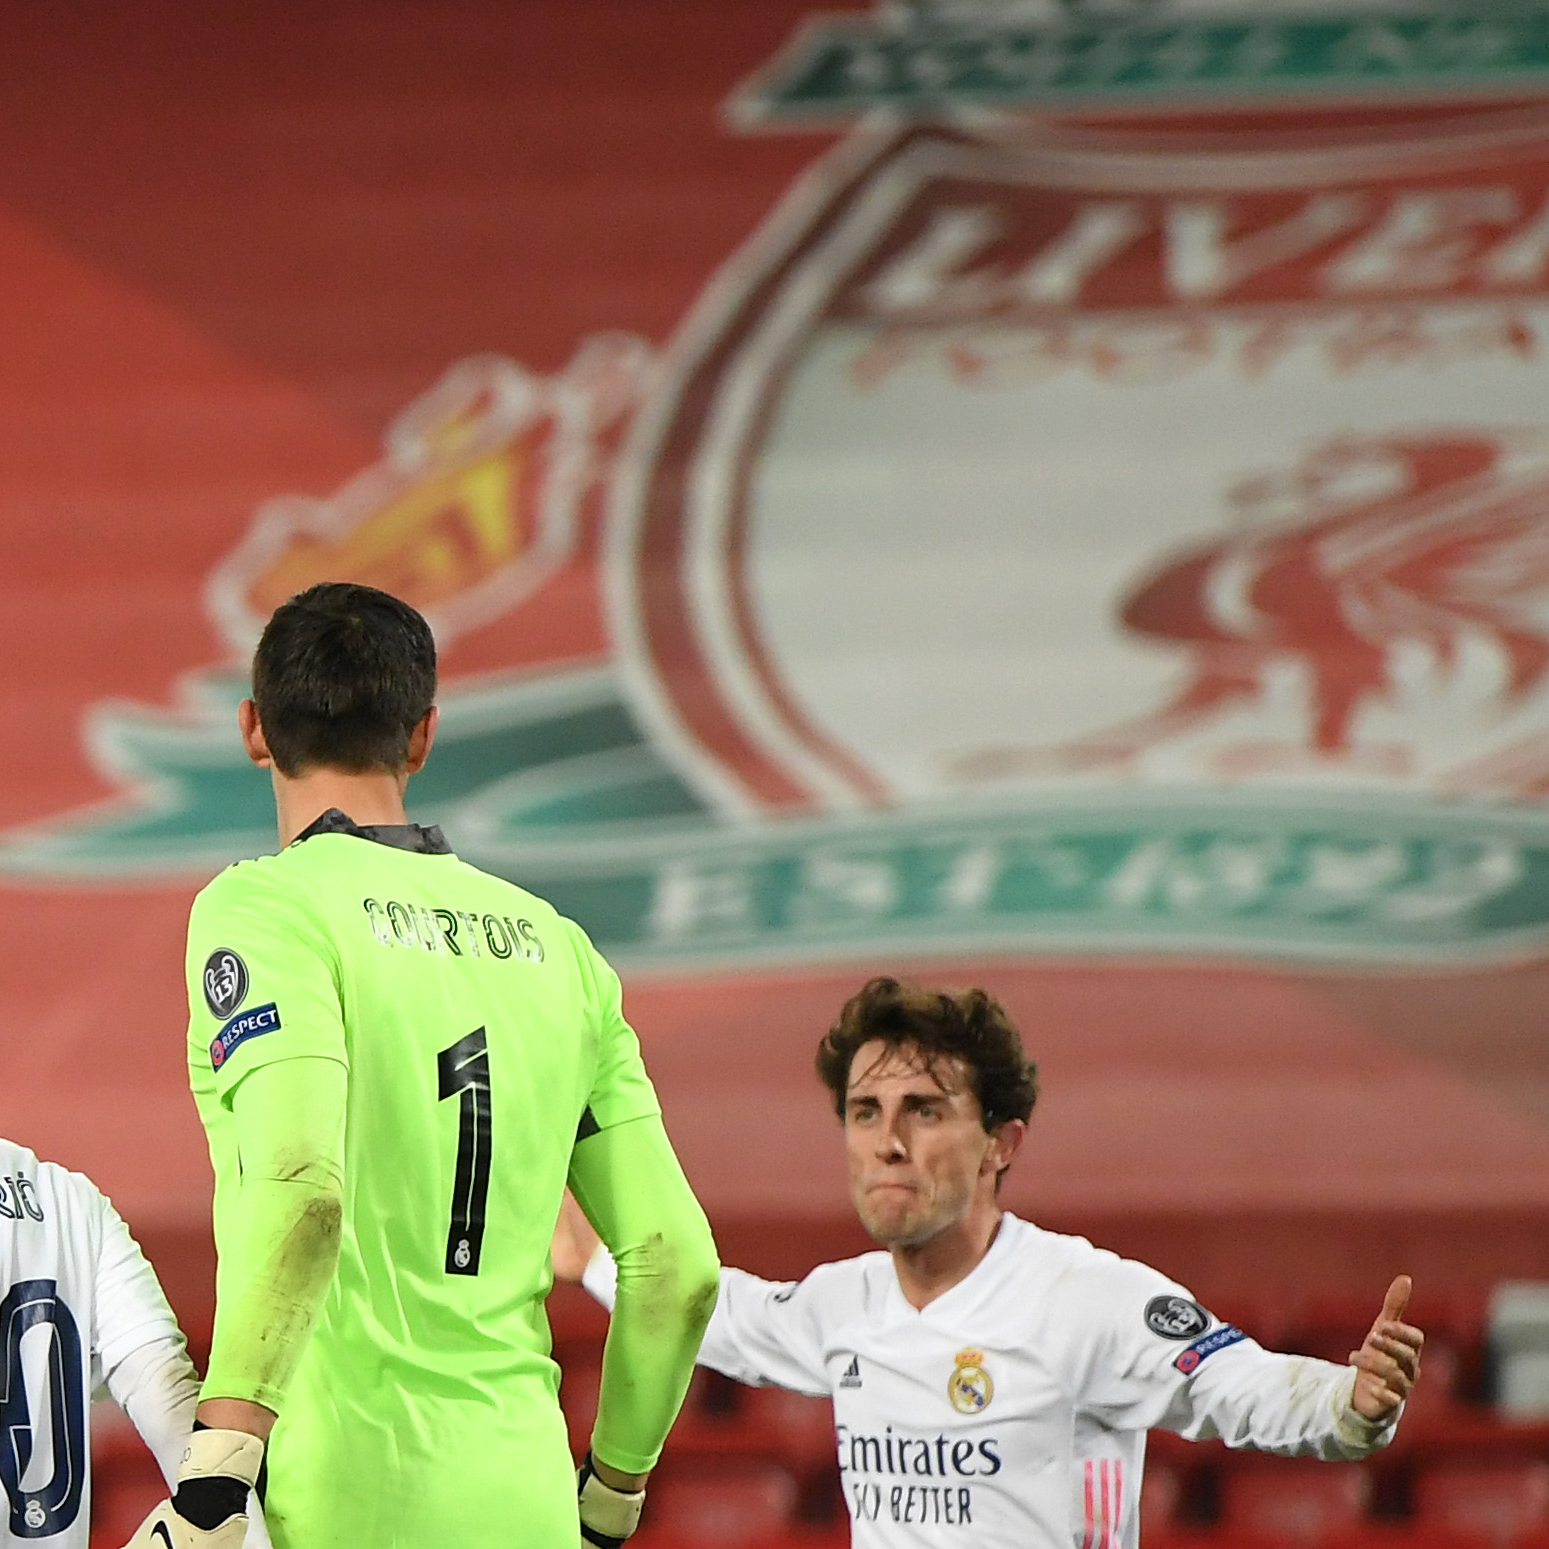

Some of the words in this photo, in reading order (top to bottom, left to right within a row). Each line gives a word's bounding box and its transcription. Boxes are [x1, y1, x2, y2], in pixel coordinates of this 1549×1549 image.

[363, 897, 545, 965] COURTOIS
[222, 1009, 277, 1049] RESPECT
[438, 1026, 495, 1277] 1
[836, 1424, 1002, 1477] Emirates
[890, 1485, 973, 1526] BETTER
